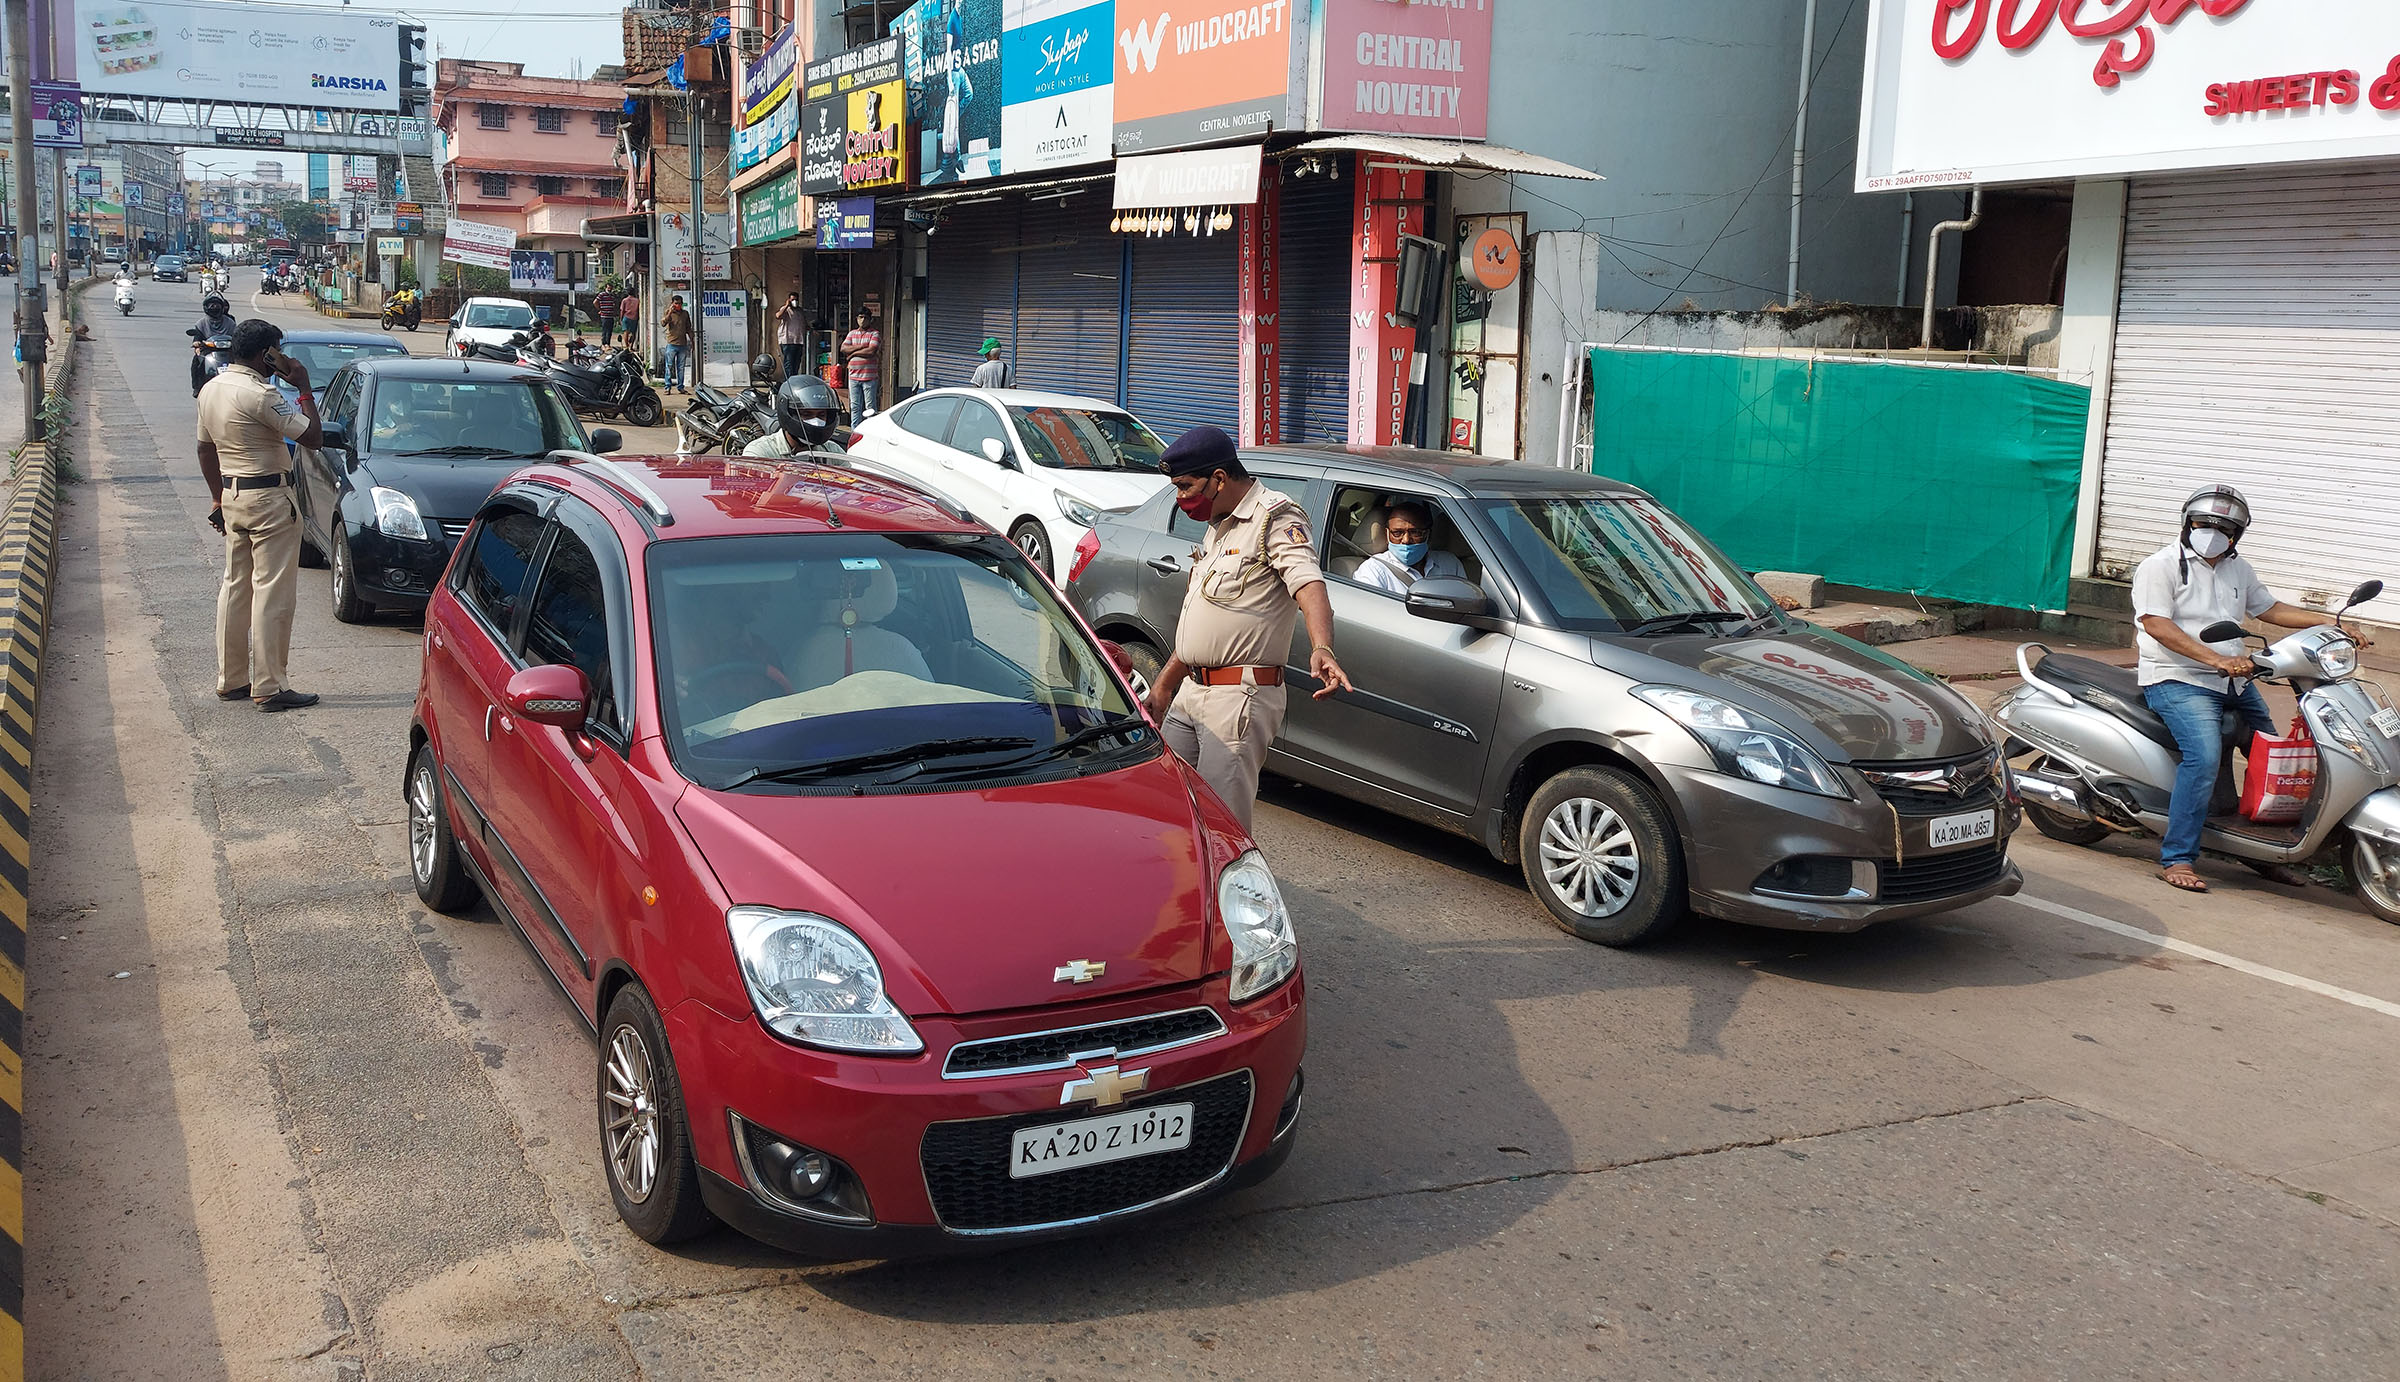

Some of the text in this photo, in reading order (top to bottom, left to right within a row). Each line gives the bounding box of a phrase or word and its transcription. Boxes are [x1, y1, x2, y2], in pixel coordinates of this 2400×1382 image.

[1176, 1, 1287, 56] WILDCRAFT
[831, 56, 842, 76] THE
[842, 51, 857, 73] BAGS
[858, 52, 862, 68] &
[879, 39, 898, 61] SHOP
[903, 7, 924, 118] CENTRAL
[924, 39, 998, 77] ALWAYS A STAR
[1035, 27, 1090, 76] Skybags
[1356, 31, 1464, 73] CENTRAL
[312, 73, 387, 91] HARSHA
[1035, 72, 1090, 93] MOVE IN STYLE
[2204, 69, 2360, 116] SWEETS
[1356, 80, 1461, 119] NOVELTY
[224, 128, 245, 136] PRASAD
[257, 130, 283, 138] HOSPITAL
[401, 123, 426, 132] GROU
[1200, 110, 1271, 132] CENTRAL NOVELTIES
[845, 123, 894, 157] Central
[1036, 134, 1088, 154] ARISTOCRAT
[843, 157, 892, 184] NOVELTY
[1159, 162, 1253, 194] WILDCRAFT
[1868, 180, 1882, 188] GST
[854, 214, 870, 228] OUTLET
[908, 212, 930, 220] SINCE
[378, 241, 403, 249] ATM
[1261, 177, 1273, 300] WILDCRAFT
[1242, 343, 1251, 448] WILDCRAF
[1261, 343, 1273, 446] WILDCRAF
[1358, 347, 1368, 445] WILDCRA
[1390, 347, 1405, 447] WILDCRA
[1433, 720, 1468, 737] DZIRE
[1106, 1125, 1122, 1149] Z
[1131, 1116, 1184, 1145] 1912
